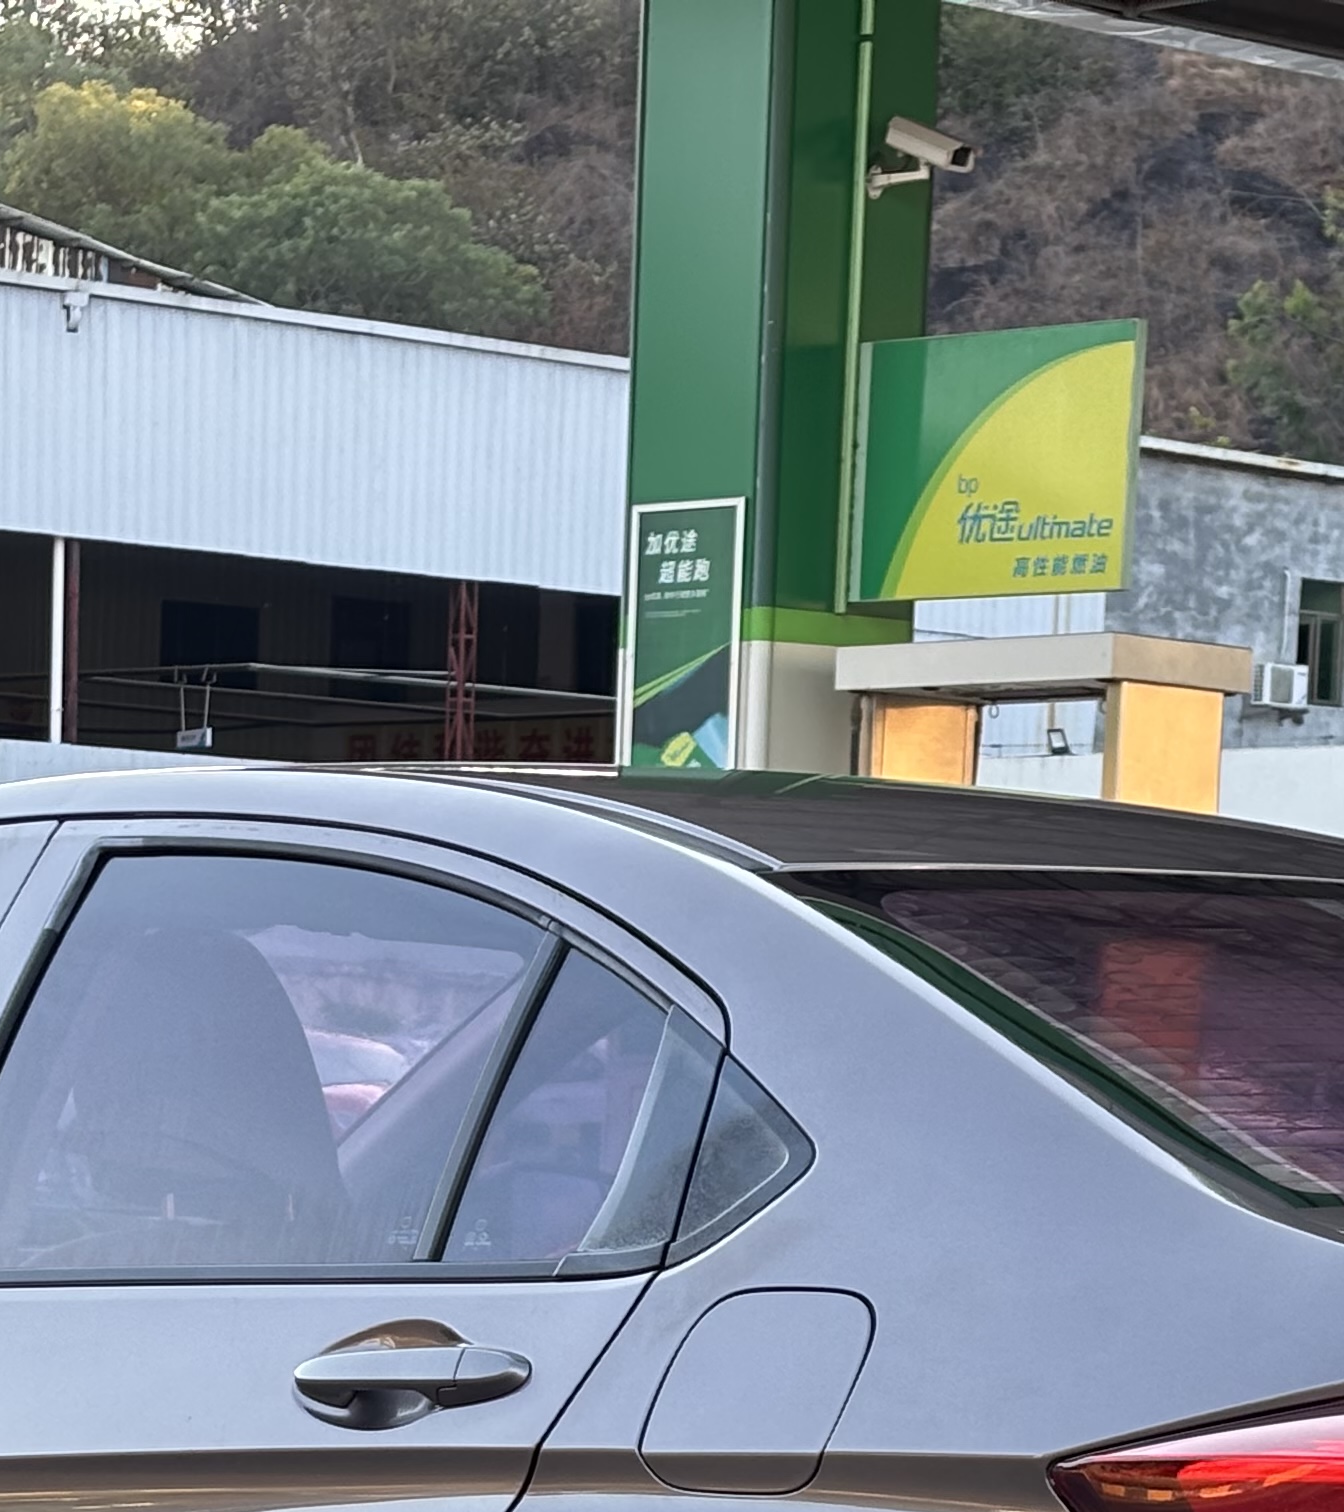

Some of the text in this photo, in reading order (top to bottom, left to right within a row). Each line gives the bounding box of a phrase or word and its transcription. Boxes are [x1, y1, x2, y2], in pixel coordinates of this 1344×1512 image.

[958, 474, 978, 497] bp
[958, 500, 1113, 544] 优途 ultimate
[644, 528, 698, 555] 加优途
[1012, 553, 1108, 577] 高性能燃油
